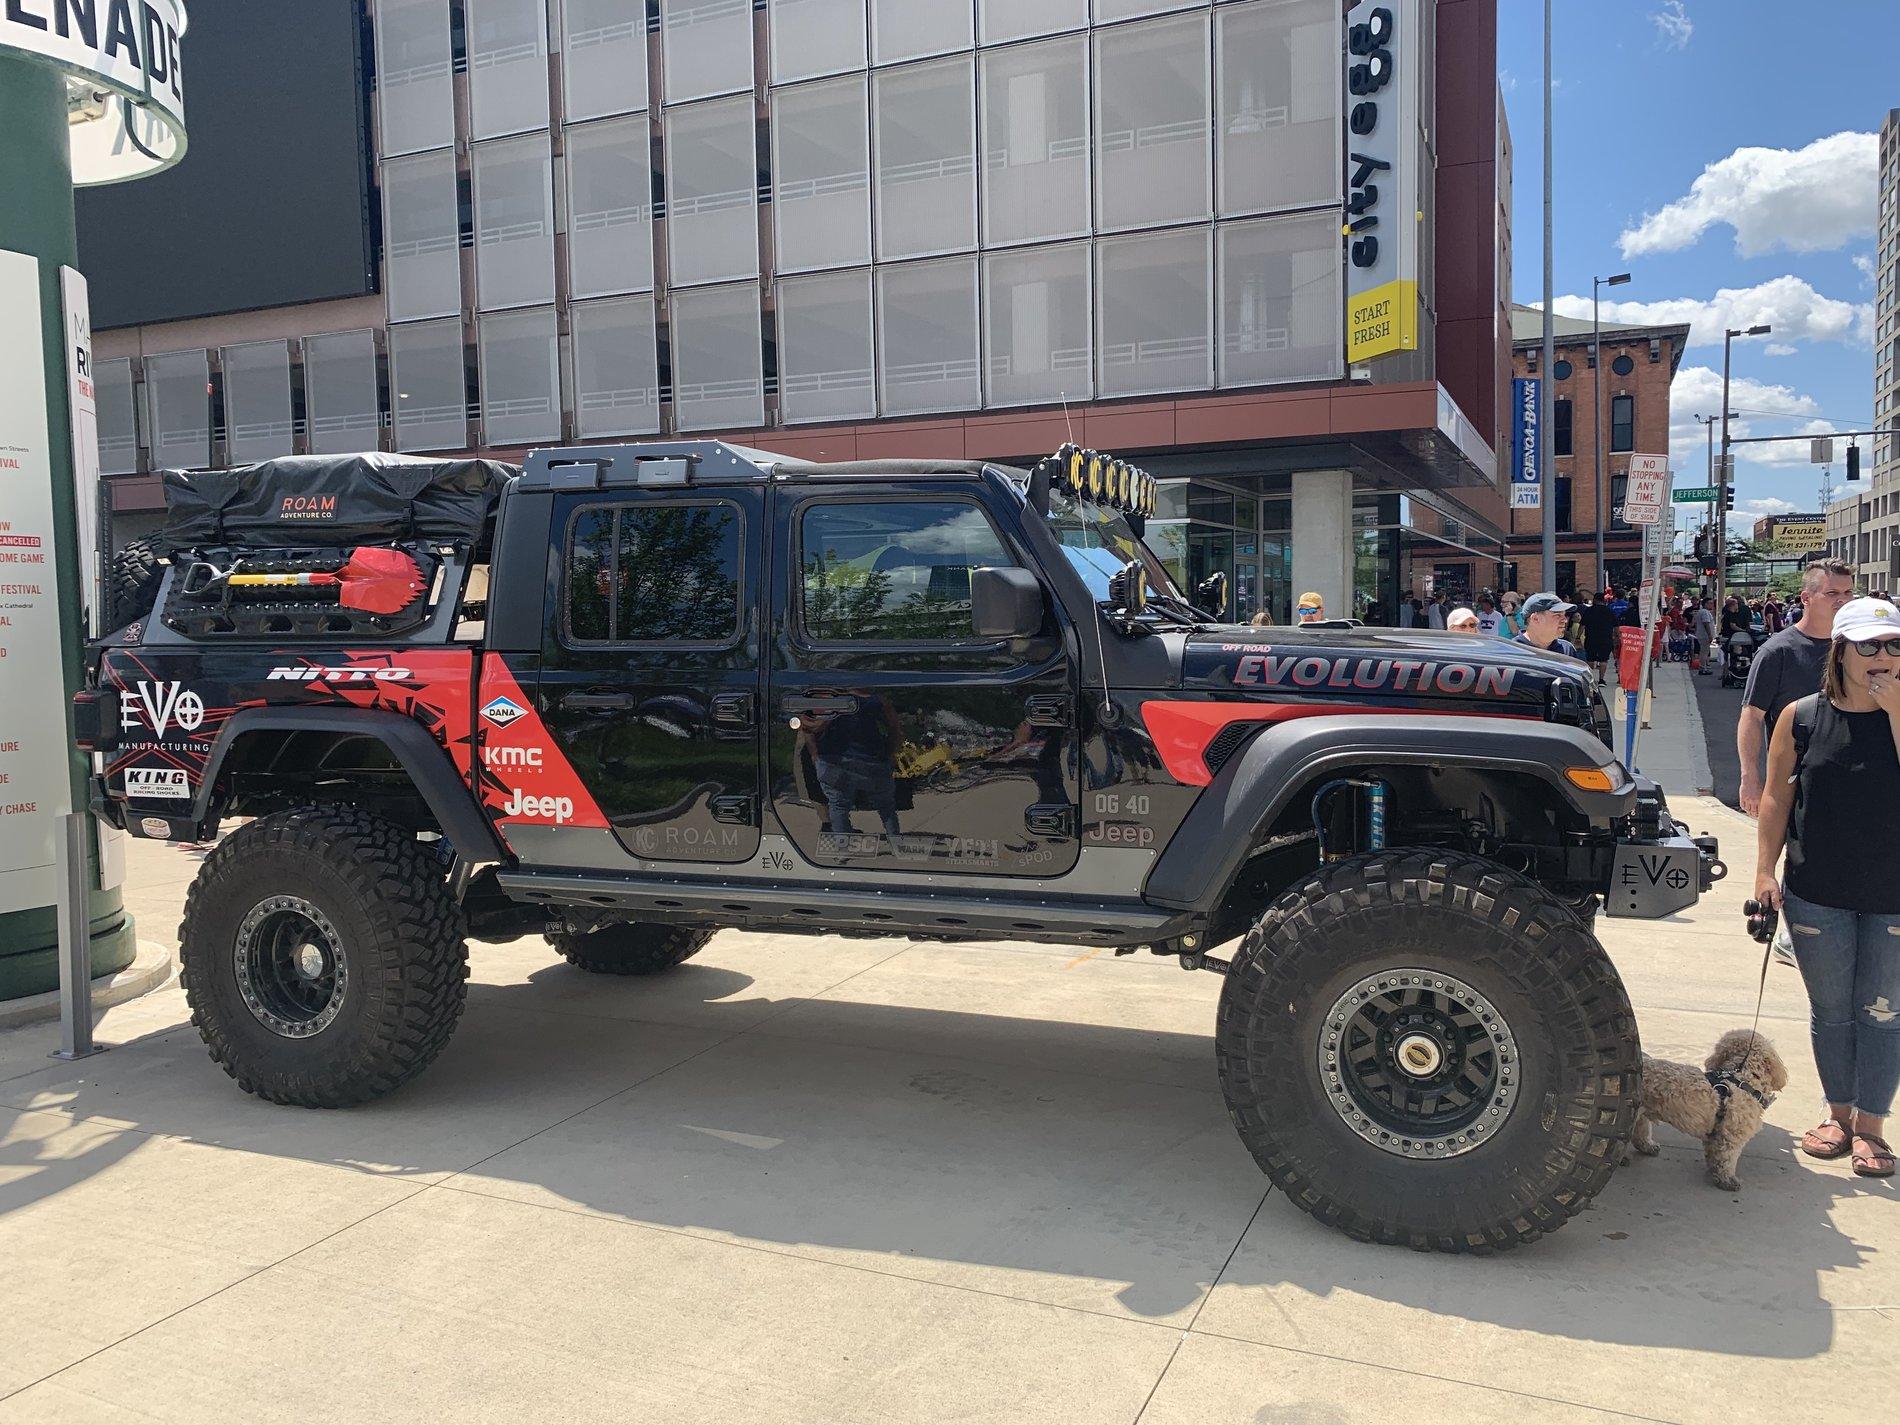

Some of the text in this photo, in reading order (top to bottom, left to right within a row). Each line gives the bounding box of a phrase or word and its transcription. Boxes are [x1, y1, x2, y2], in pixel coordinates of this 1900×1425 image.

[1349, 7, 1393, 268] city egg
[1353, 300, 1391, 325] START
[1353, 320, 1391, 346] FRESH
[8, 445, 30, 453] Streets
[1070, 451, 1084, 490] KC
[1642, 460, 1656, 469] NO
[1088, 457, 1102, 496] KC
[1631, 471, 1665, 480] STOPPING
[1637, 482, 1656, 491] ANY
[1516, 493, 1539, 504] ATM
[1635, 492, 1656, 502] TIME
[1674, 488, 1719, 499] JEFFERSON
[282, 496, 336, 511] ROAM
[1644, 506, 1658, 514] SIDE
[1781, 526, 1825, 535] Jennite
[20, 553, 45, 564] GAME
[1, 584, 42, 595] FESTIVAL
[1222, 643, 1272, 653] OFF ROAD
[266, 667, 414, 680] NITTO
[1233, 655, 1517, 696] EVOLUTION
[120, 681, 205, 739] EVO
[489, 708, 516, 717] DANA
[117, 742, 210, 752] MANUFACTURING
[485, 766, 543, 774] WHEELS
[127, 770, 185, 785] KING
[5, 802, 37, 815] CHASE
[504, 788, 574, 824] Jeep
[1125, 795, 1150, 815] 40
[665, 827, 739, 846] ROAM
[1089, 820, 1155, 847] Jeep
[835, 834, 877, 853] PSC
